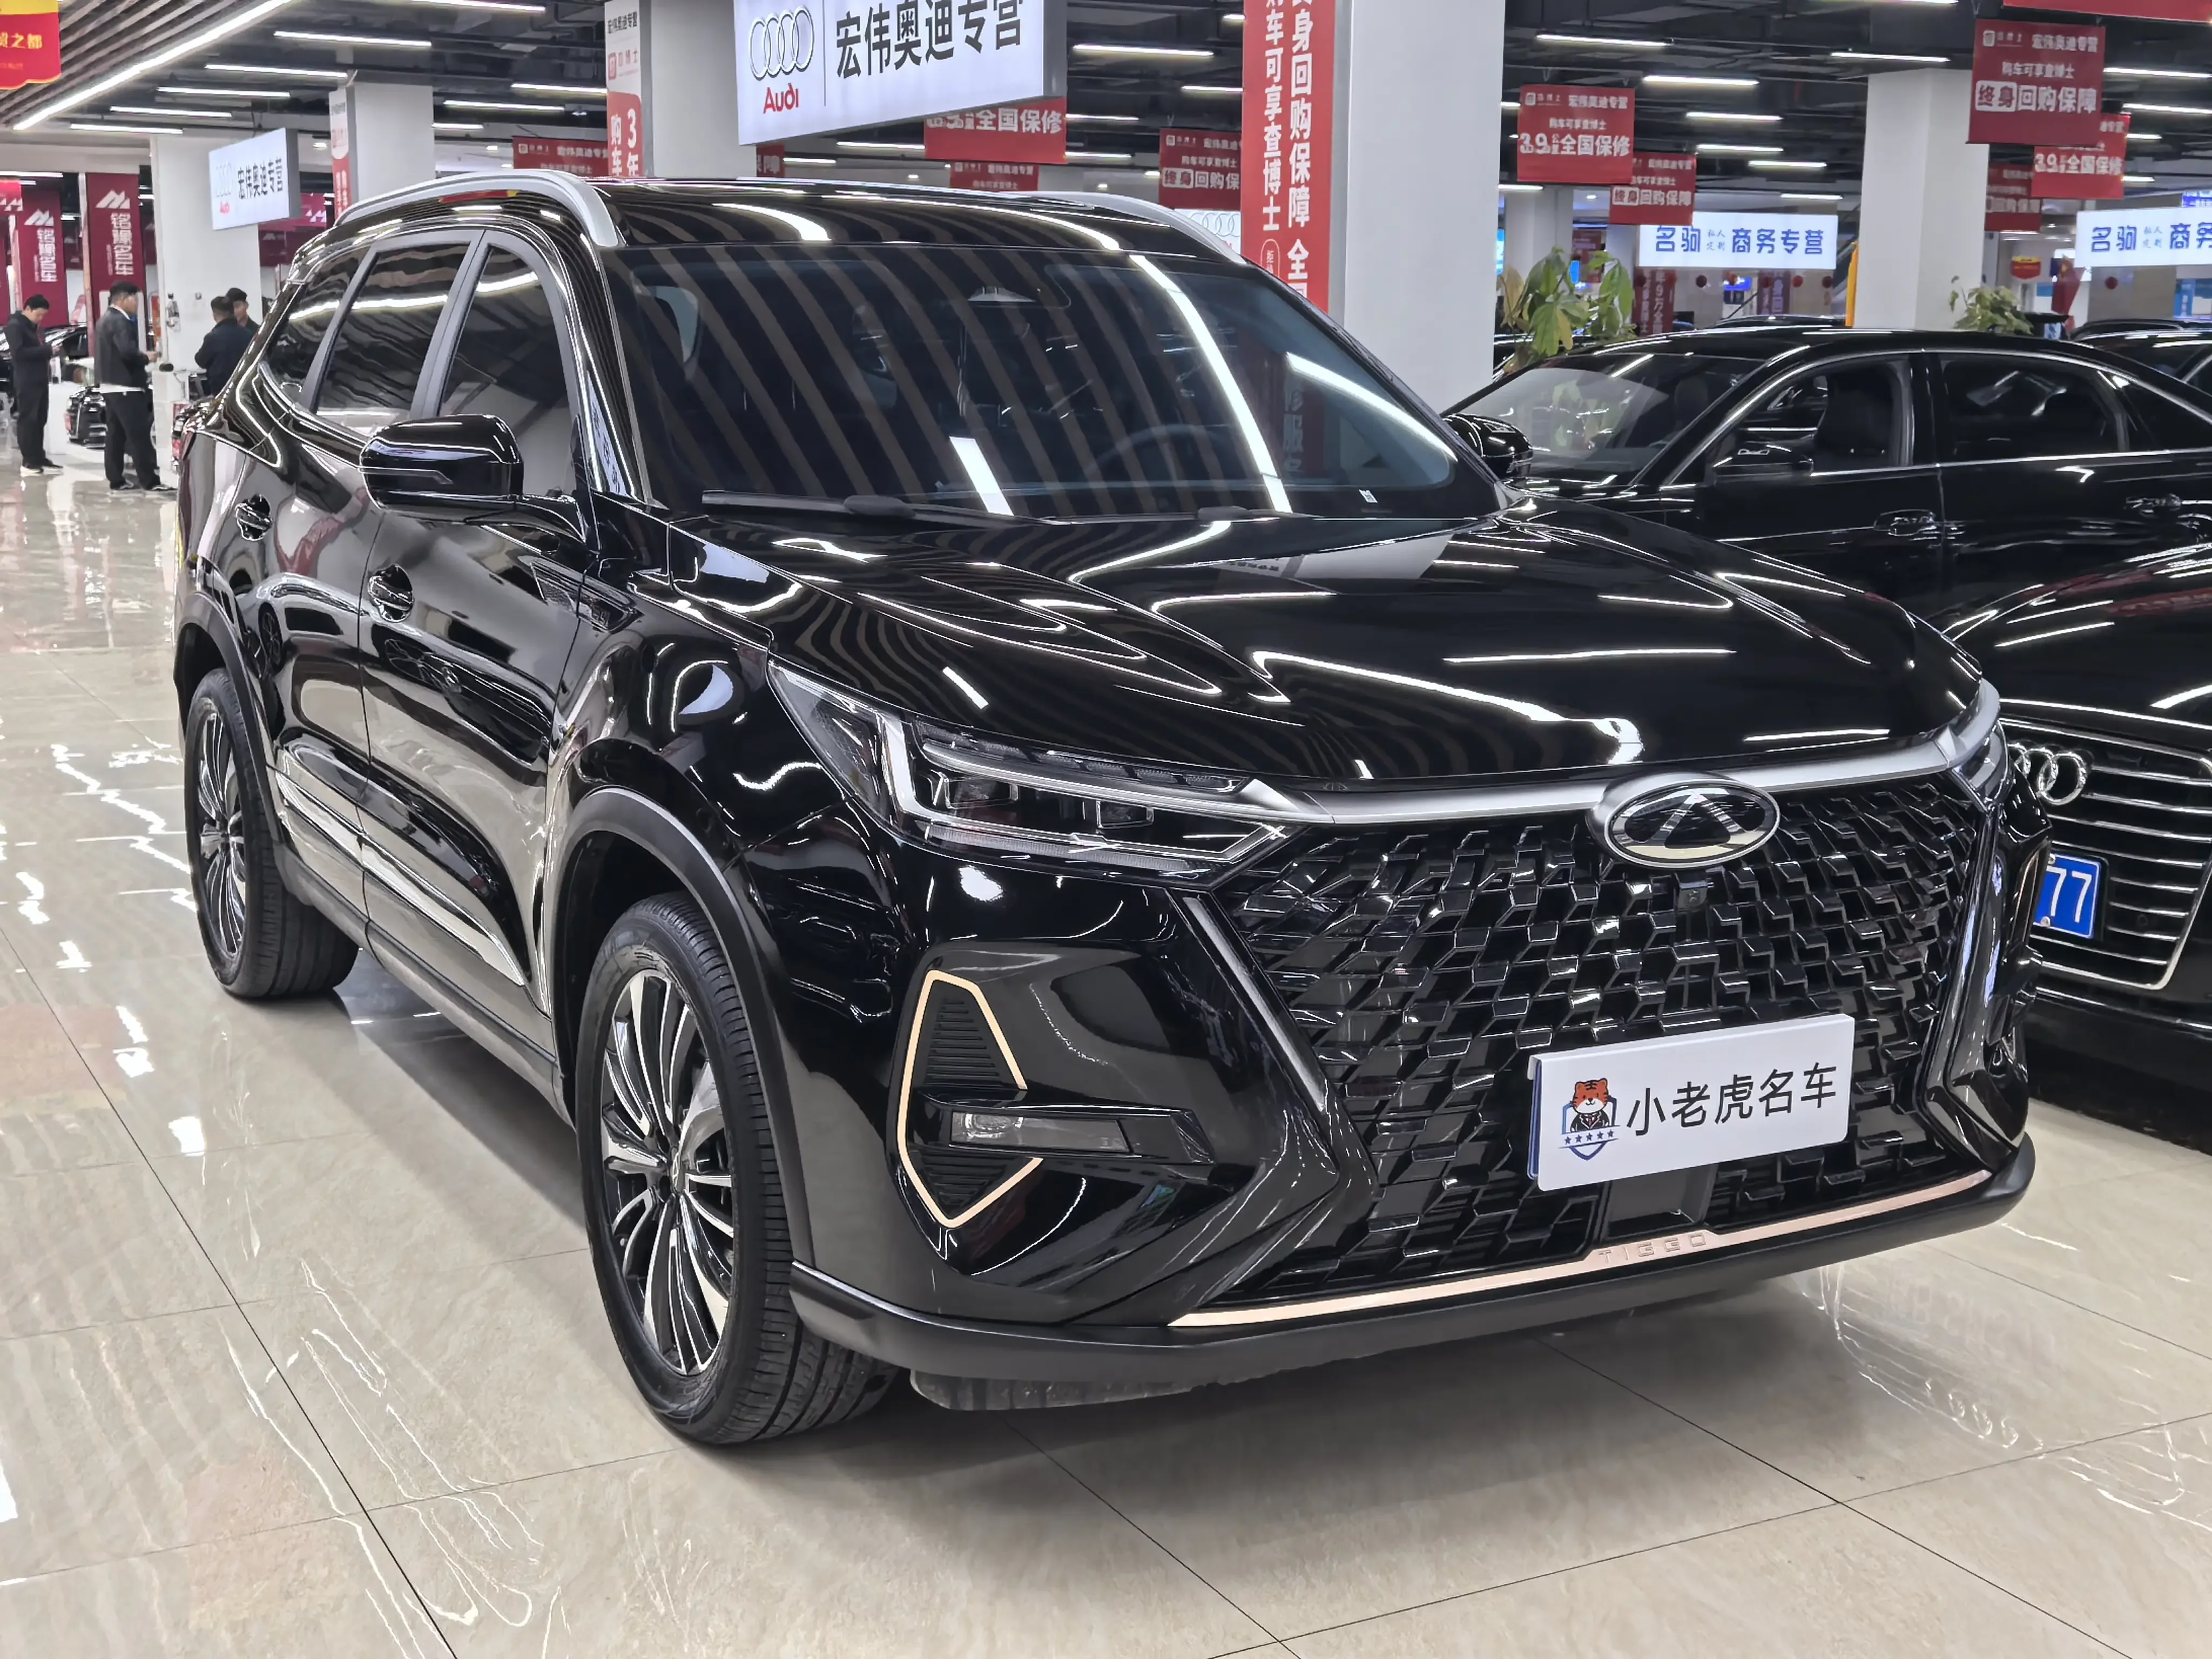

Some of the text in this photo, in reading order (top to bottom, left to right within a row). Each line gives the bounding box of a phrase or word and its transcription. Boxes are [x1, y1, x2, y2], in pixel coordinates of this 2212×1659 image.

[837, 0, 1022, 79] 宏伟奥迪专营
[762, 83, 799, 114] Audi
[1262, 0, 1284, 231] 车可享查博士
[1288, 0, 1313, 228] 身回购保障
[1977, 83, 2096, 113] 终身回购保障
[1656, 225, 1824, 255] 名驹 商务专营
[2091, 225, 2137, 252] 名驹
[2046, 865, 2092, 923] 77
[1626, 1062, 1837, 1136] 小老虎名车
[1599, 1233, 1706, 1264] TIGGO
